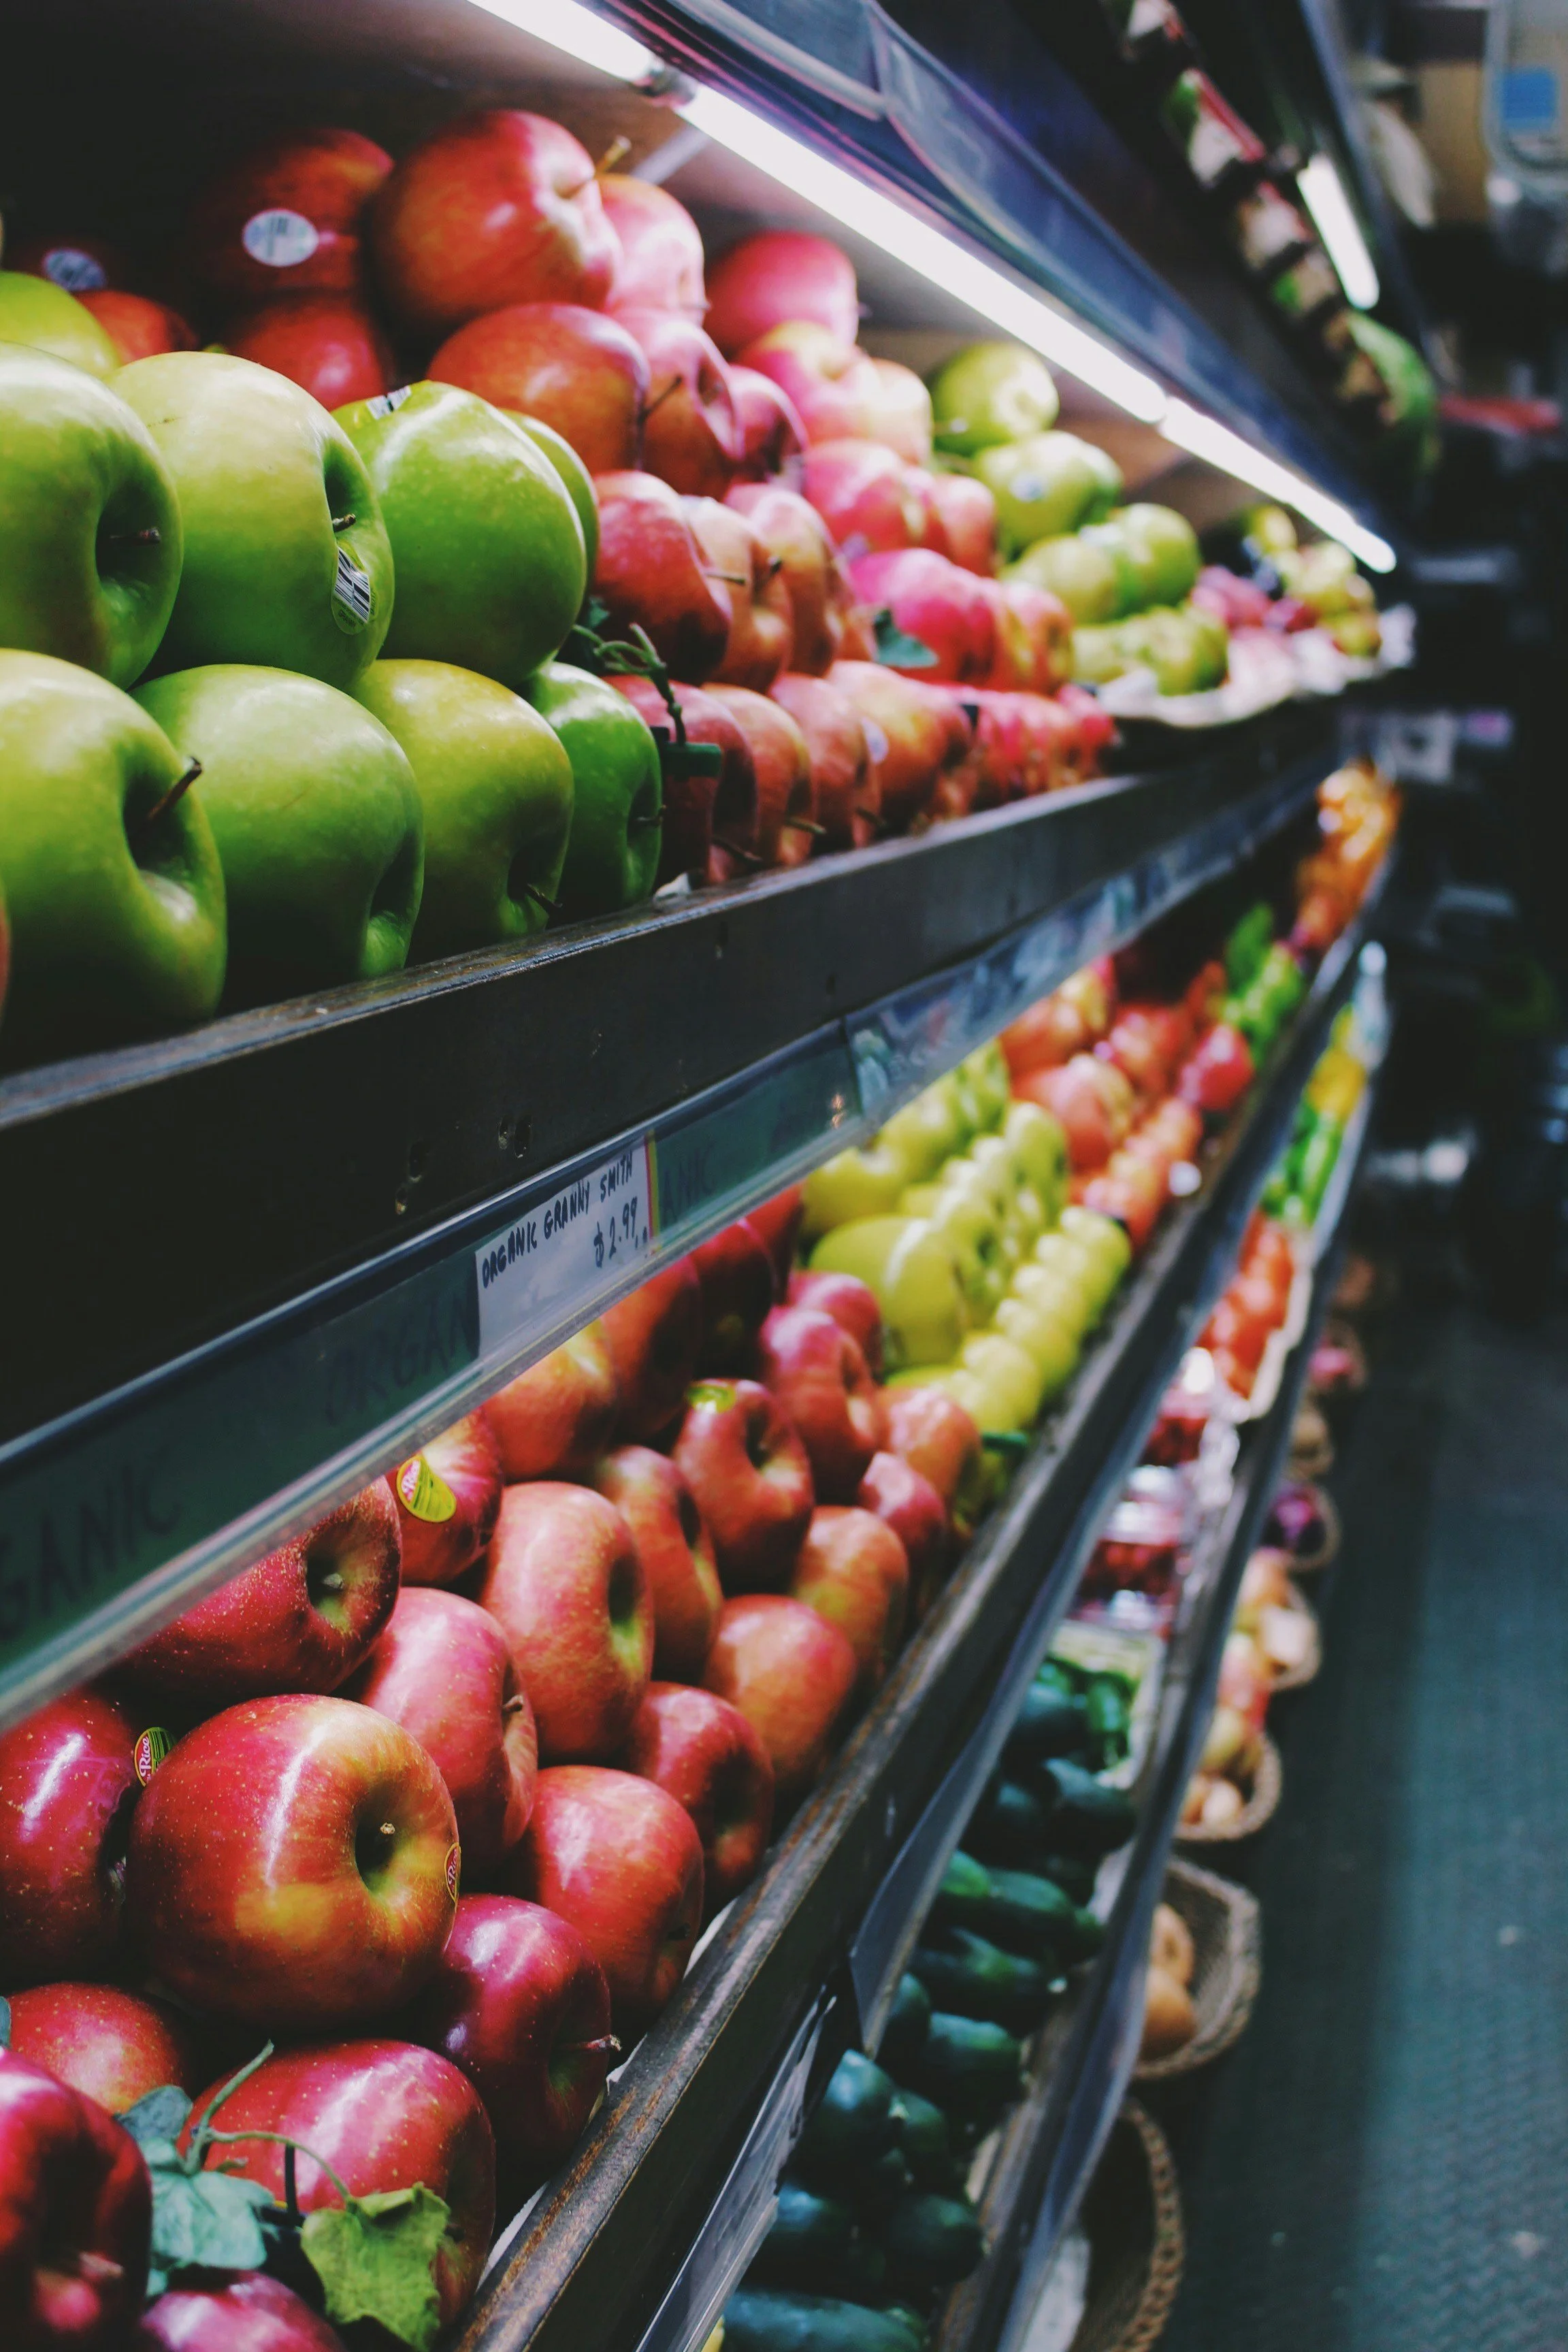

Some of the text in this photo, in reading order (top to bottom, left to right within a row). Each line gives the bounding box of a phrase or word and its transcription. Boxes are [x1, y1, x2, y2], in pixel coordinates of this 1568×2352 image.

[482, 1221, 537, 1288] ORGANIC
[544, 1180, 591, 1240] GRANNY
[600, 1149, 633, 1203] SMITH
[140, 1736, 151, 1777] Rice
[448, 1848, 457, 1884] Rice
